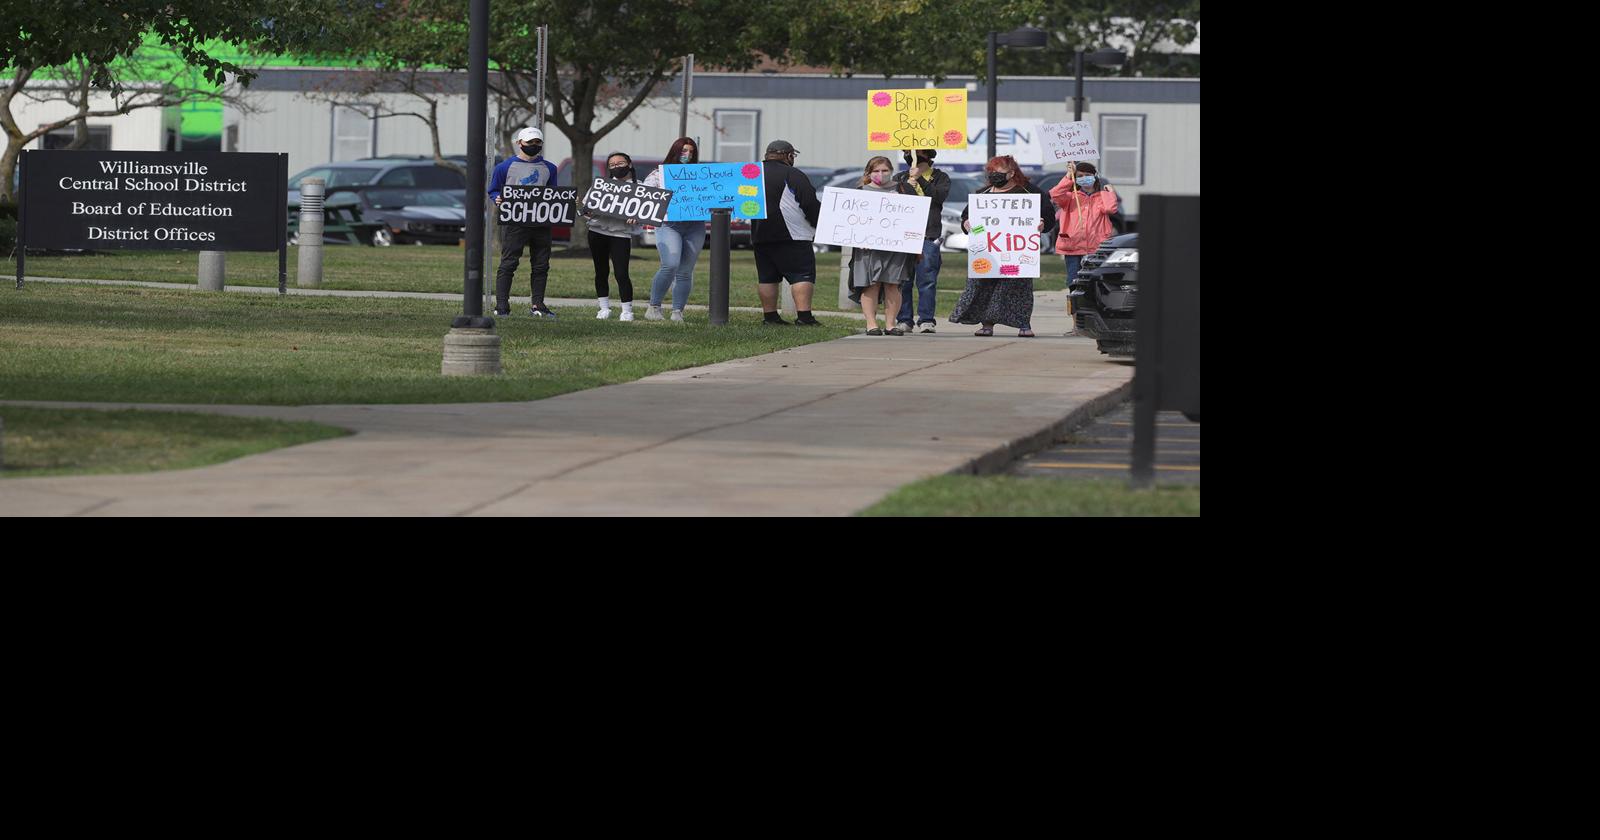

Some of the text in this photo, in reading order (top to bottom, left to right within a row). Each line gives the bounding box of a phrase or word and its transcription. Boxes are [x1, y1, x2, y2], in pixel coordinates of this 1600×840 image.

[895, 92, 938, 112] Bring
[899, 113, 935, 131] Back
[891, 130, 939, 148] School
[1069, 139, 1090, 148] Good
[1055, 149, 1097, 160] Education
[99, 161, 208, 175] Williamsville
[668, 167, 697, 180] Why
[701, 167, 733, 179] Should
[59, 177, 247, 192] Central School District
[594, 178, 670, 201] BRING BACK
[503, 186, 576, 201] BRING BACK
[72, 202, 233, 217] Board of Education
[587, 190, 663, 223] SCHOOL
[831, 192, 869, 212] Take
[500, 201, 573, 224] SCHOOL
[88, 227, 216, 242] District Offices
[833, 225, 904, 246] Education
